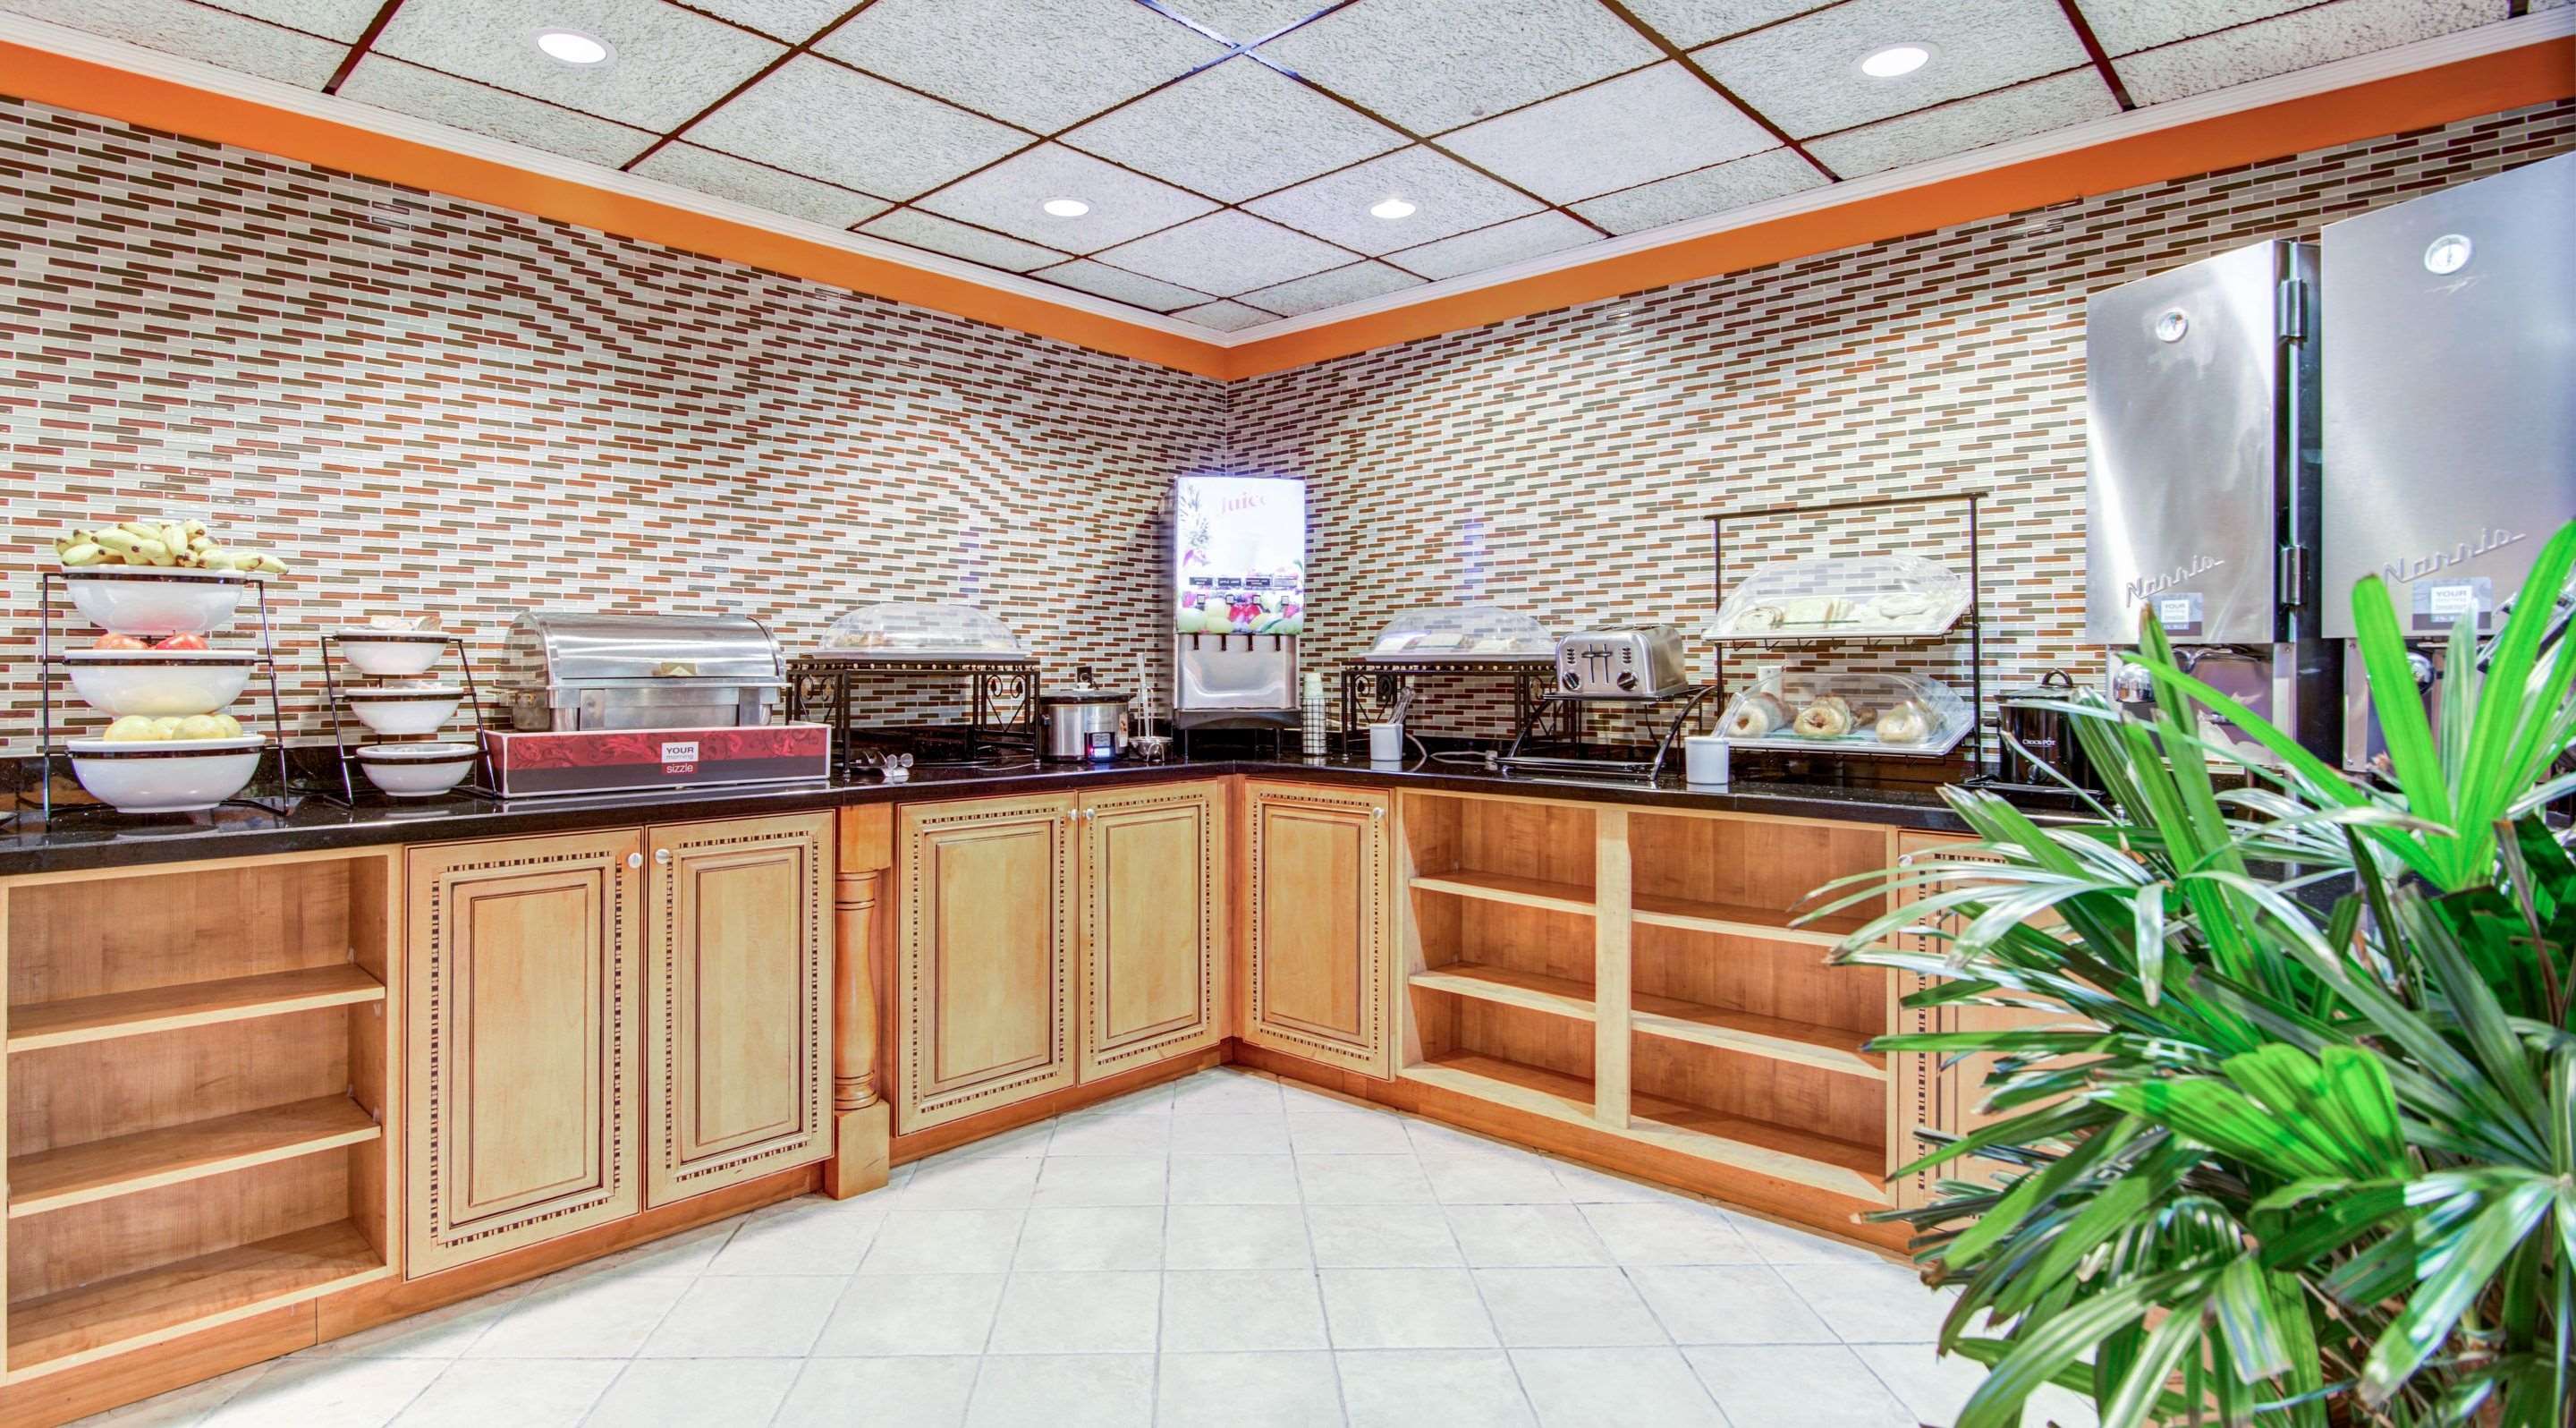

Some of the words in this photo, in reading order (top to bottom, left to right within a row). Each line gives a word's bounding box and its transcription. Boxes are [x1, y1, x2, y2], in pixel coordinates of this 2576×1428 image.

[2382, 528, 2527, 588] Norris
[2126, 554, 2225, 608] Norris
[666, 746, 694, 754] YOUR
[666, 763, 693, 774] sizzle
